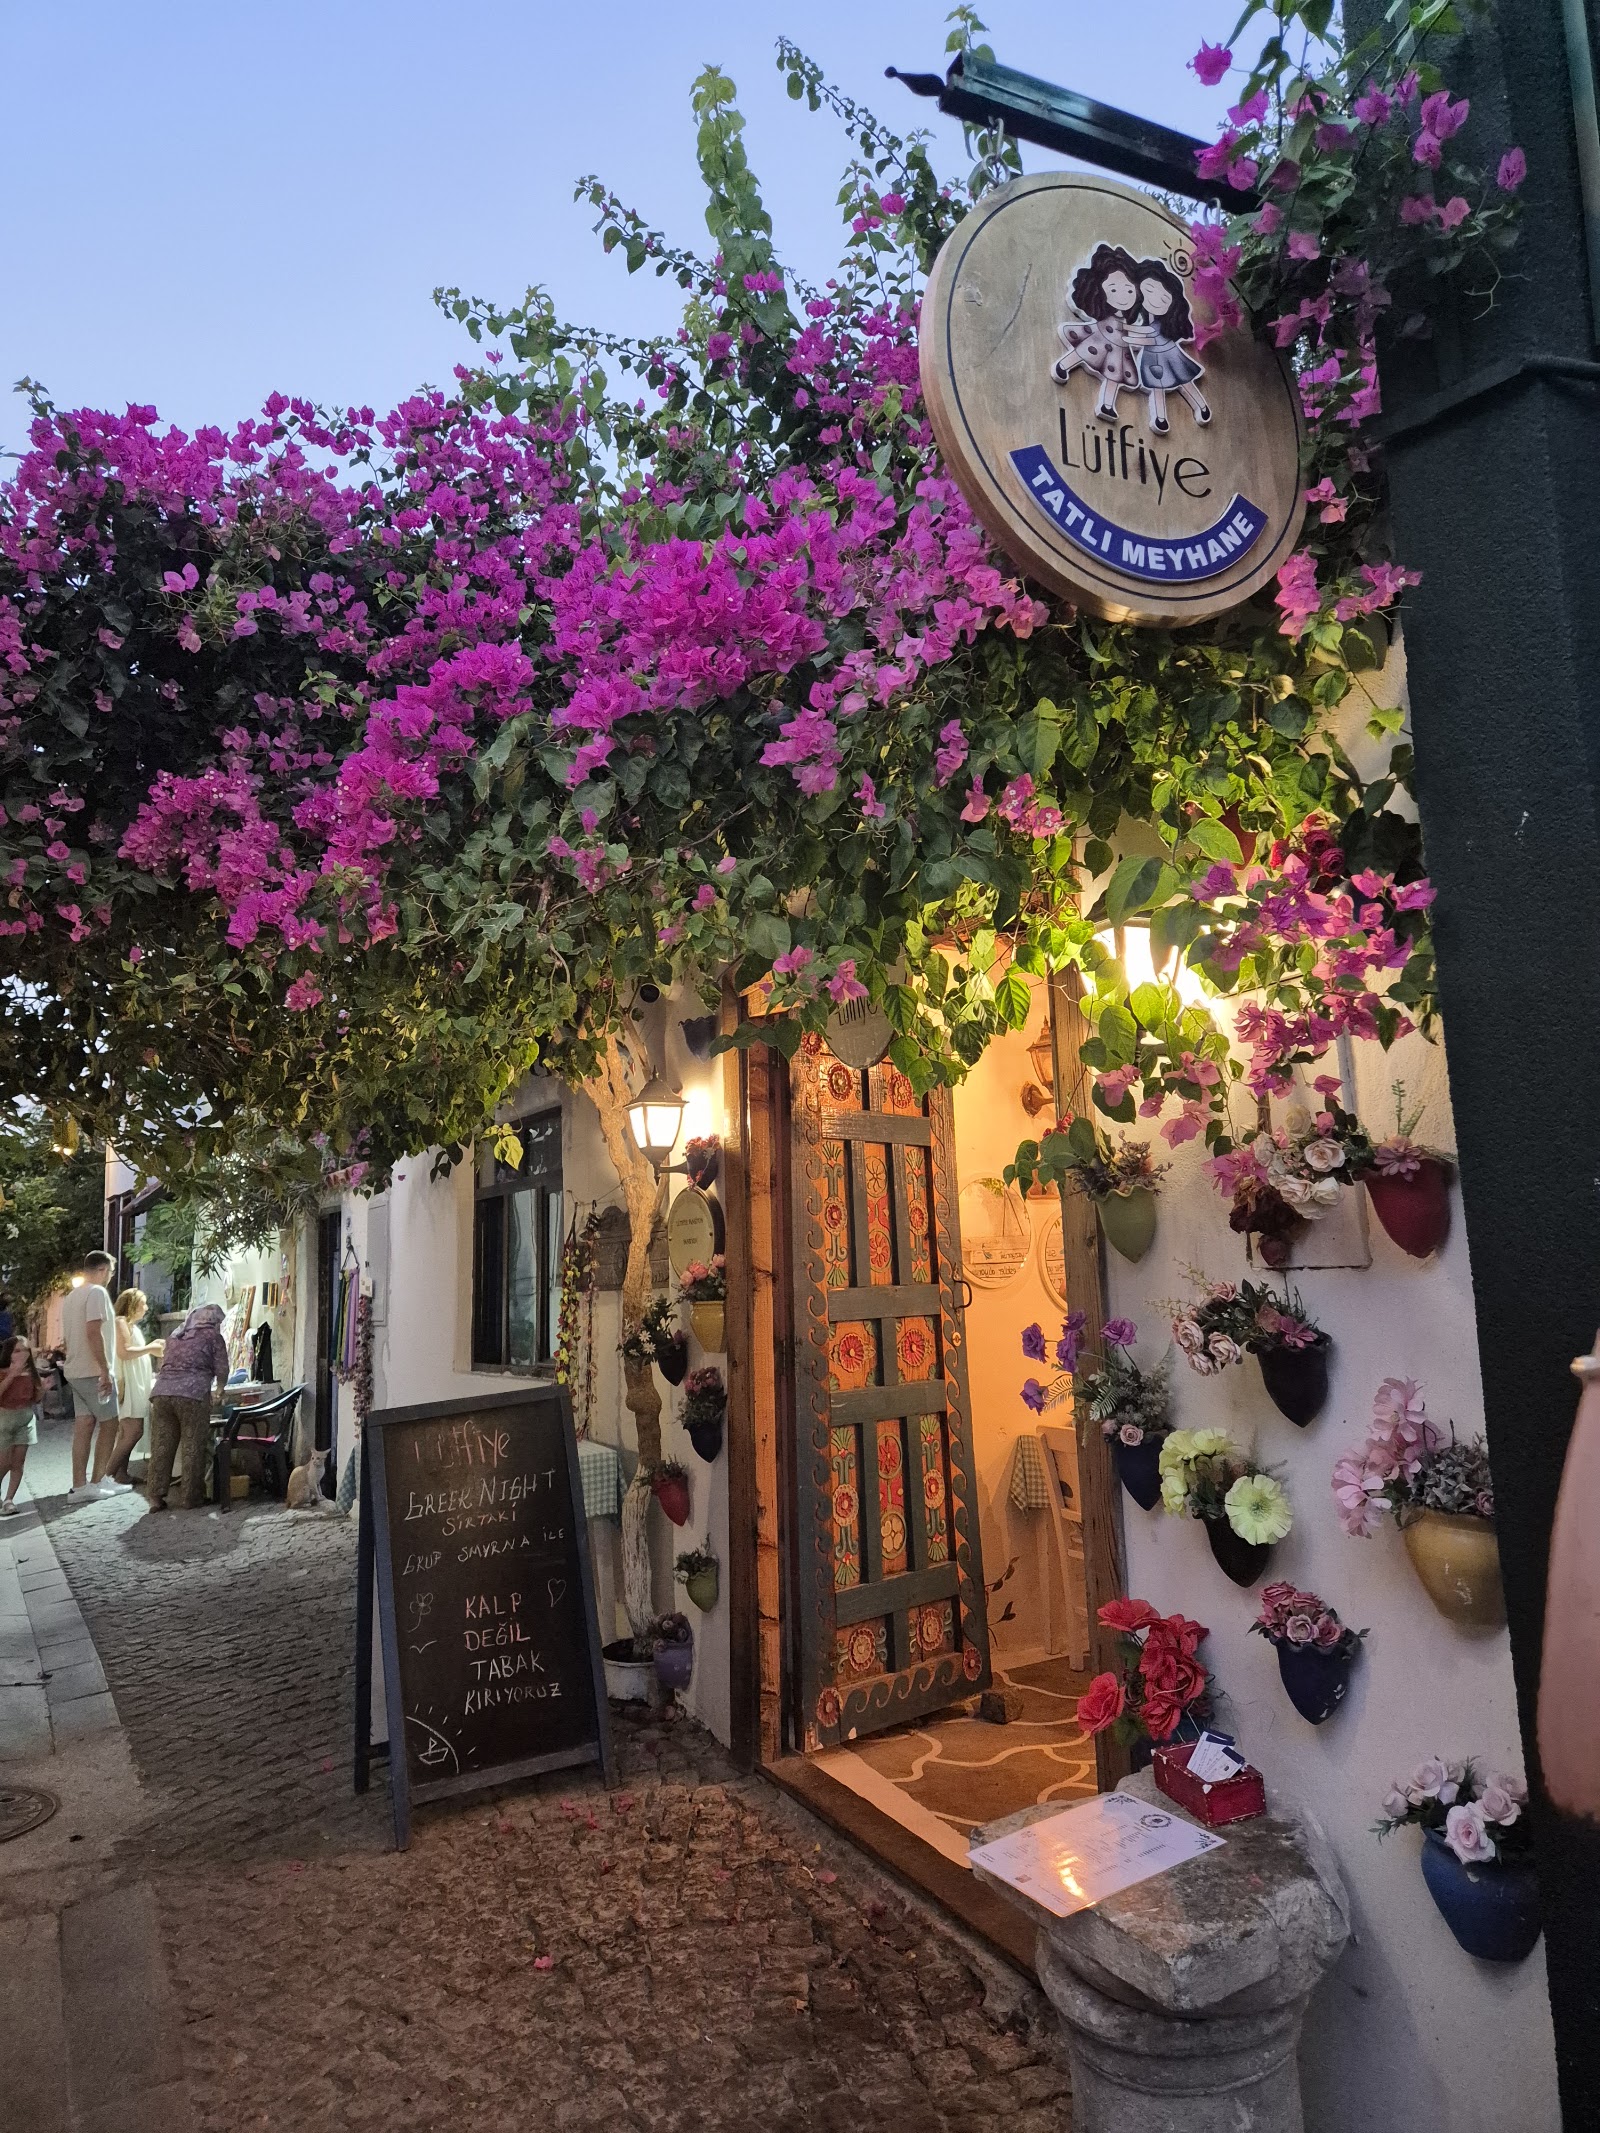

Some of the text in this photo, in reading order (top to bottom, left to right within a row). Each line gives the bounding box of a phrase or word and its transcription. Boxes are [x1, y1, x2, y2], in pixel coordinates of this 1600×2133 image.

[1059, 407, 1211, 505] Lütfiye
[1032, 464, 1254, 570] TATLI MEYHANE
[404, 1467, 556, 1521] GREEK NIGHT
[457, 1535, 530, 1562] SMYRNA
[465, 1592, 521, 1619] KALP
[463, 1617, 531, 1651] DEĞİL
[469, 1649, 545, 1682] TABAK
[464, 1682, 562, 1715] KIRIYORUZ
